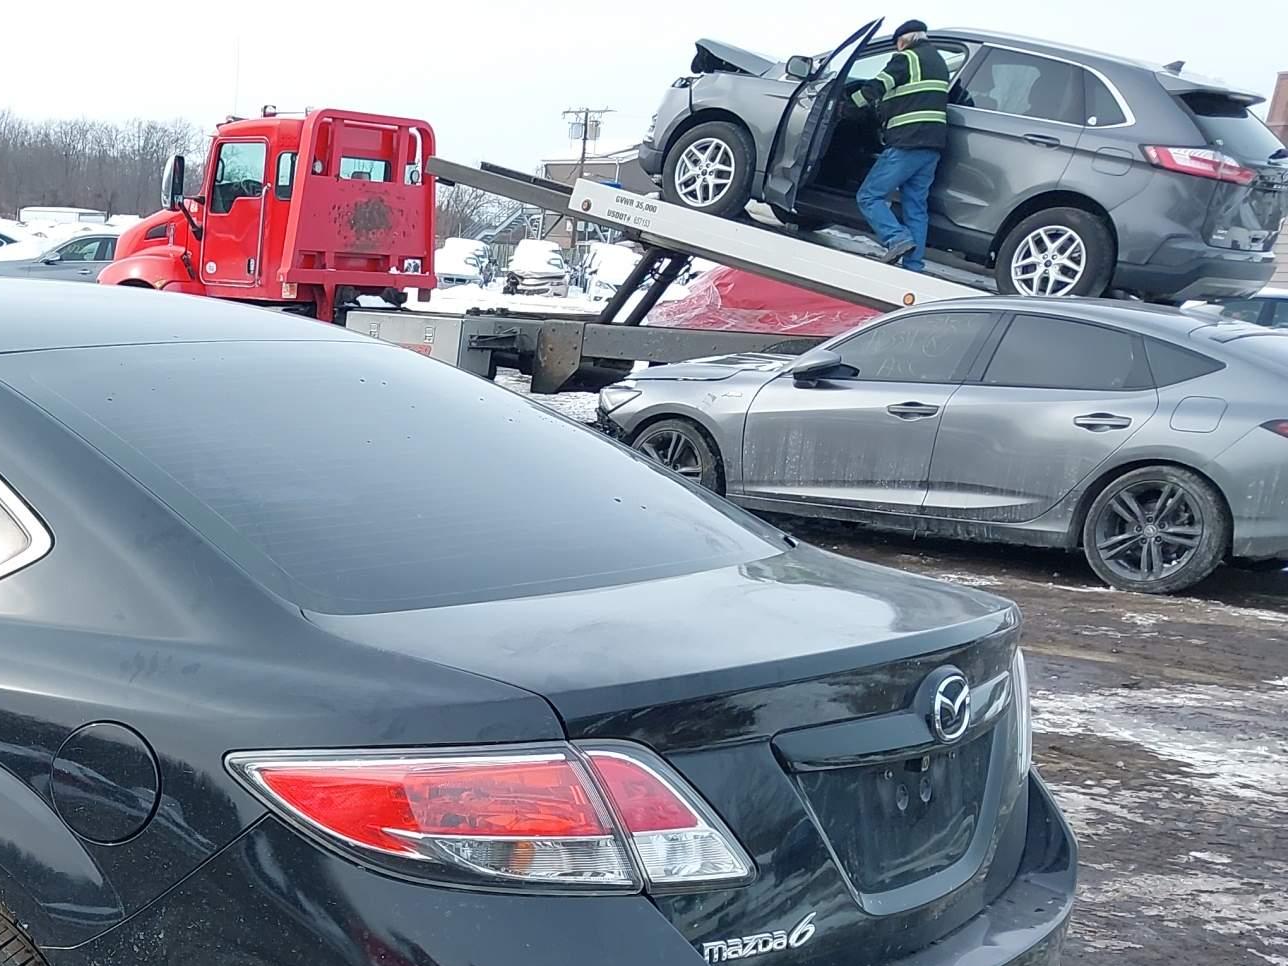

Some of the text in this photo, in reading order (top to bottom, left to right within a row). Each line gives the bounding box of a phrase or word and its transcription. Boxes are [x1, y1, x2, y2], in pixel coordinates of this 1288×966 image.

[615, 195, 658, 213] GVWR 35,000
[607, 209, 631, 222] USDOT#
